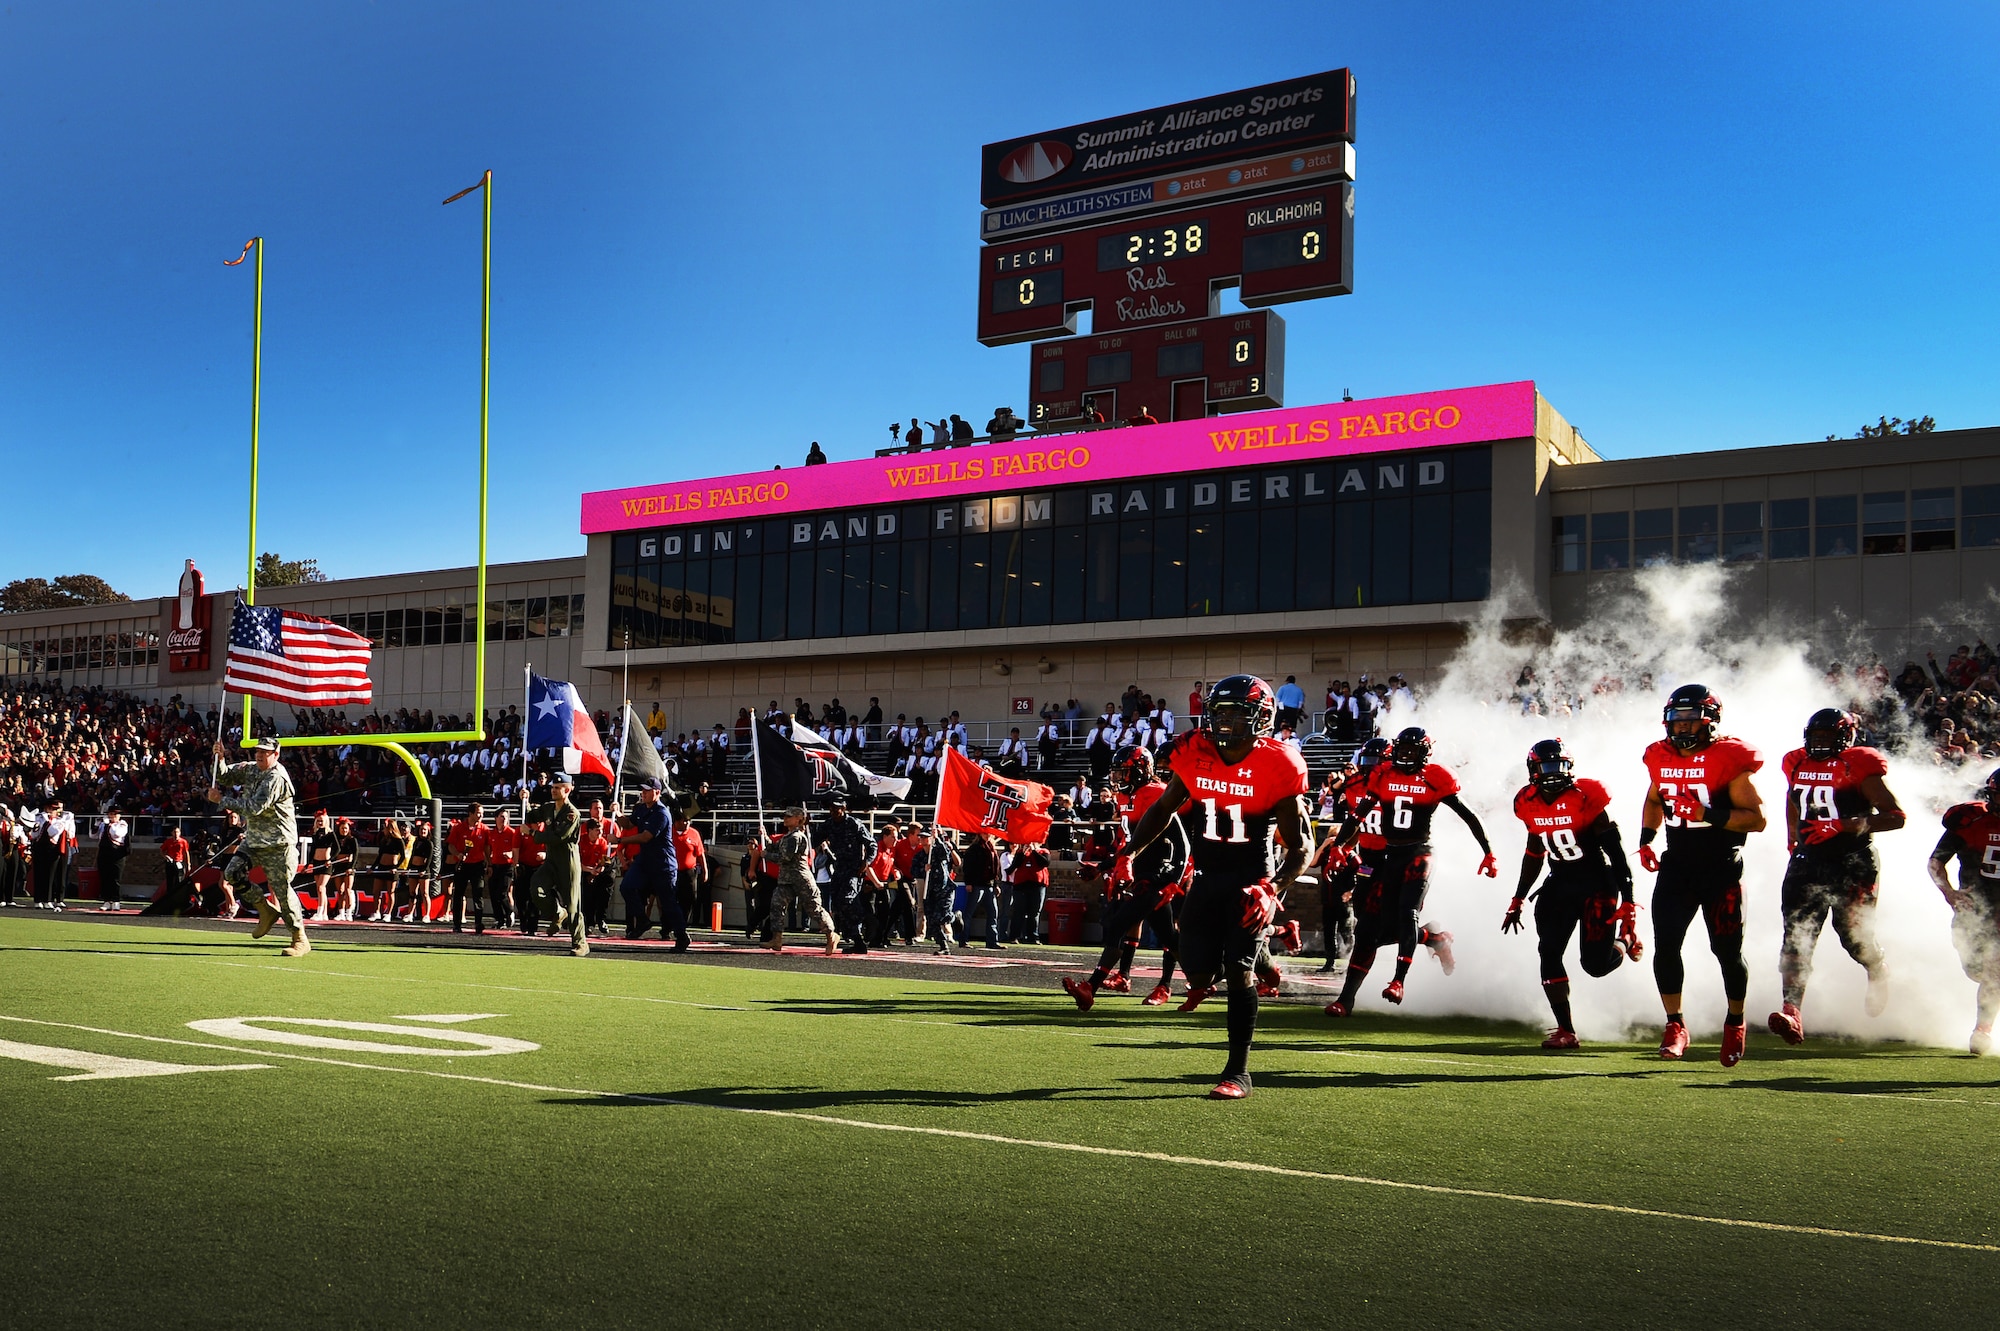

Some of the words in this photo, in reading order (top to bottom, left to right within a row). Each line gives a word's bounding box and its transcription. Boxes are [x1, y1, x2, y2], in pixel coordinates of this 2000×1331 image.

[1075, 119, 1155, 151] Summit
[1160, 104, 1245, 134] Alliance
[1248, 85, 1324, 119] Sports
[1082, 129, 1240, 172] Administration
[1241, 110, 1315, 140] Center
[1183, 176, 1206, 192] at&t
[1244, 165, 1268, 180] at&t
[1307, 154, 1332, 169] at&t
[1003, 210, 1036, 227] UMC
[1038, 197, 1094, 220] HEALTH
[1095, 185, 1152, 210] SYSTEM
[1247, 201, 1323, 227] OKLAHOMA
[1125, 225, 1203, 263] 2:38
[1301, 231, 1320, 260] 0
[998, 248, 1054, 270] TECH
[1018, 278, 1035, 306] 0
[1126, 266, 1176, 292] Red
[1115, 297, 1186, 323] Raiders
[1099, 340, 1109, 350] TO
[1111, 338, 1122, 348] GO
[1165, 330, 1184, 341] BALL
[1186, 327, 1198, 338] ON
[1043, 346, 1063, 358] DOWN
[1235, 340, 1249, 363] 0
[1220, 387, 1237, 396] LEFT
[1250, 377, 1260, 393] 3
[1055, 406, 1070, 416] LEFT
[1208, 420, 1330, 453] WELLS
[1338, 404, 1462, 440] FARGO
[885, 459, 984, 488] WELLS
[990, 447, 1091, 477] FARGO
[621, 492, 703, 518] WELLS
[707, 481, 790, 509] FARGO
[639, 528, 754, 558] GOIN'
[793, 513, 896, 543] BAND
[935, 497, 1051, 531] FROM
[1090, 461, 1446, 516] RAIDERLAND
[1016, 700, 1029, 711] 26
[1660, 767, 1684, 779] TEXAS
[1685, 768, 1705, 779] TECH
[1798, 772, 1816, 781] TEXAS
[1817, 772, 1833, 781] TECH
[1196, 777, 1227, 793] TEXAS
[1229, 782, 1254, 797] TECH
[1388, 783, 1409, 793] TEXAS
[1410, 785, 1427, 794] TECH
[1393, 795, 1414, 829] 6
[1793, 783, 1839, 821] 79
[1200, 798, 1250, 843] 11
[1533, 817, 1553, 826] TEXAS
[1555, 815, 1573, 825] TECH
[1539, 828, 1584, 861] 18
